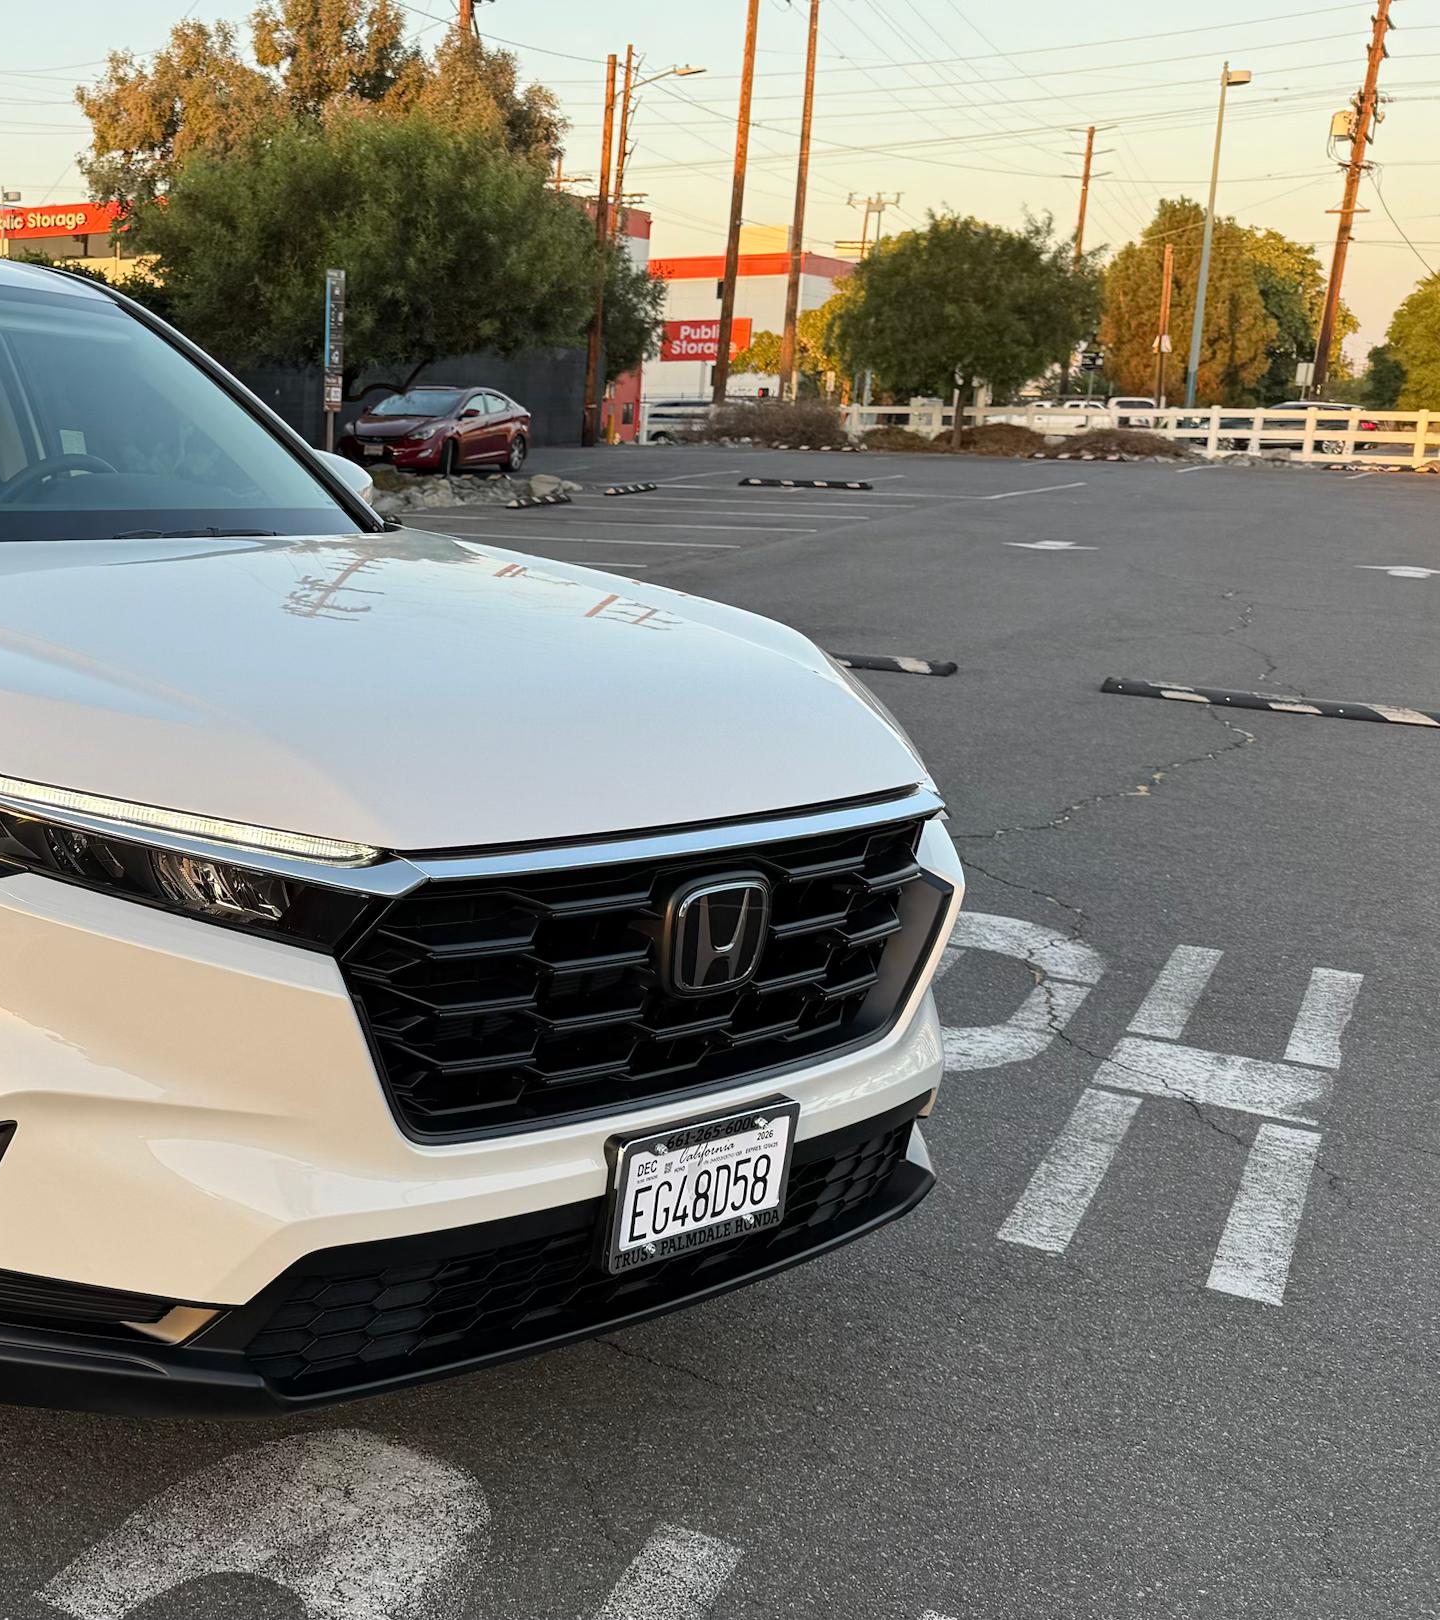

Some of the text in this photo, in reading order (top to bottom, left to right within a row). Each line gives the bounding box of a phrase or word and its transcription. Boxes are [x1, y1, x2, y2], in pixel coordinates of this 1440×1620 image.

[27, 212, 86, 230] Storage
[680, 324, 720, 339] Publi
[671, 340, 737, 356] Storae
[637, 1160, 658, 1177] DEC
[679, 1140, 735, 1166] California
[756, 1130, 773, 1141] 2026
[628, 1154, 772, 1243] EG48D58
[661, 1223, 731, 1255] PALMDALE
